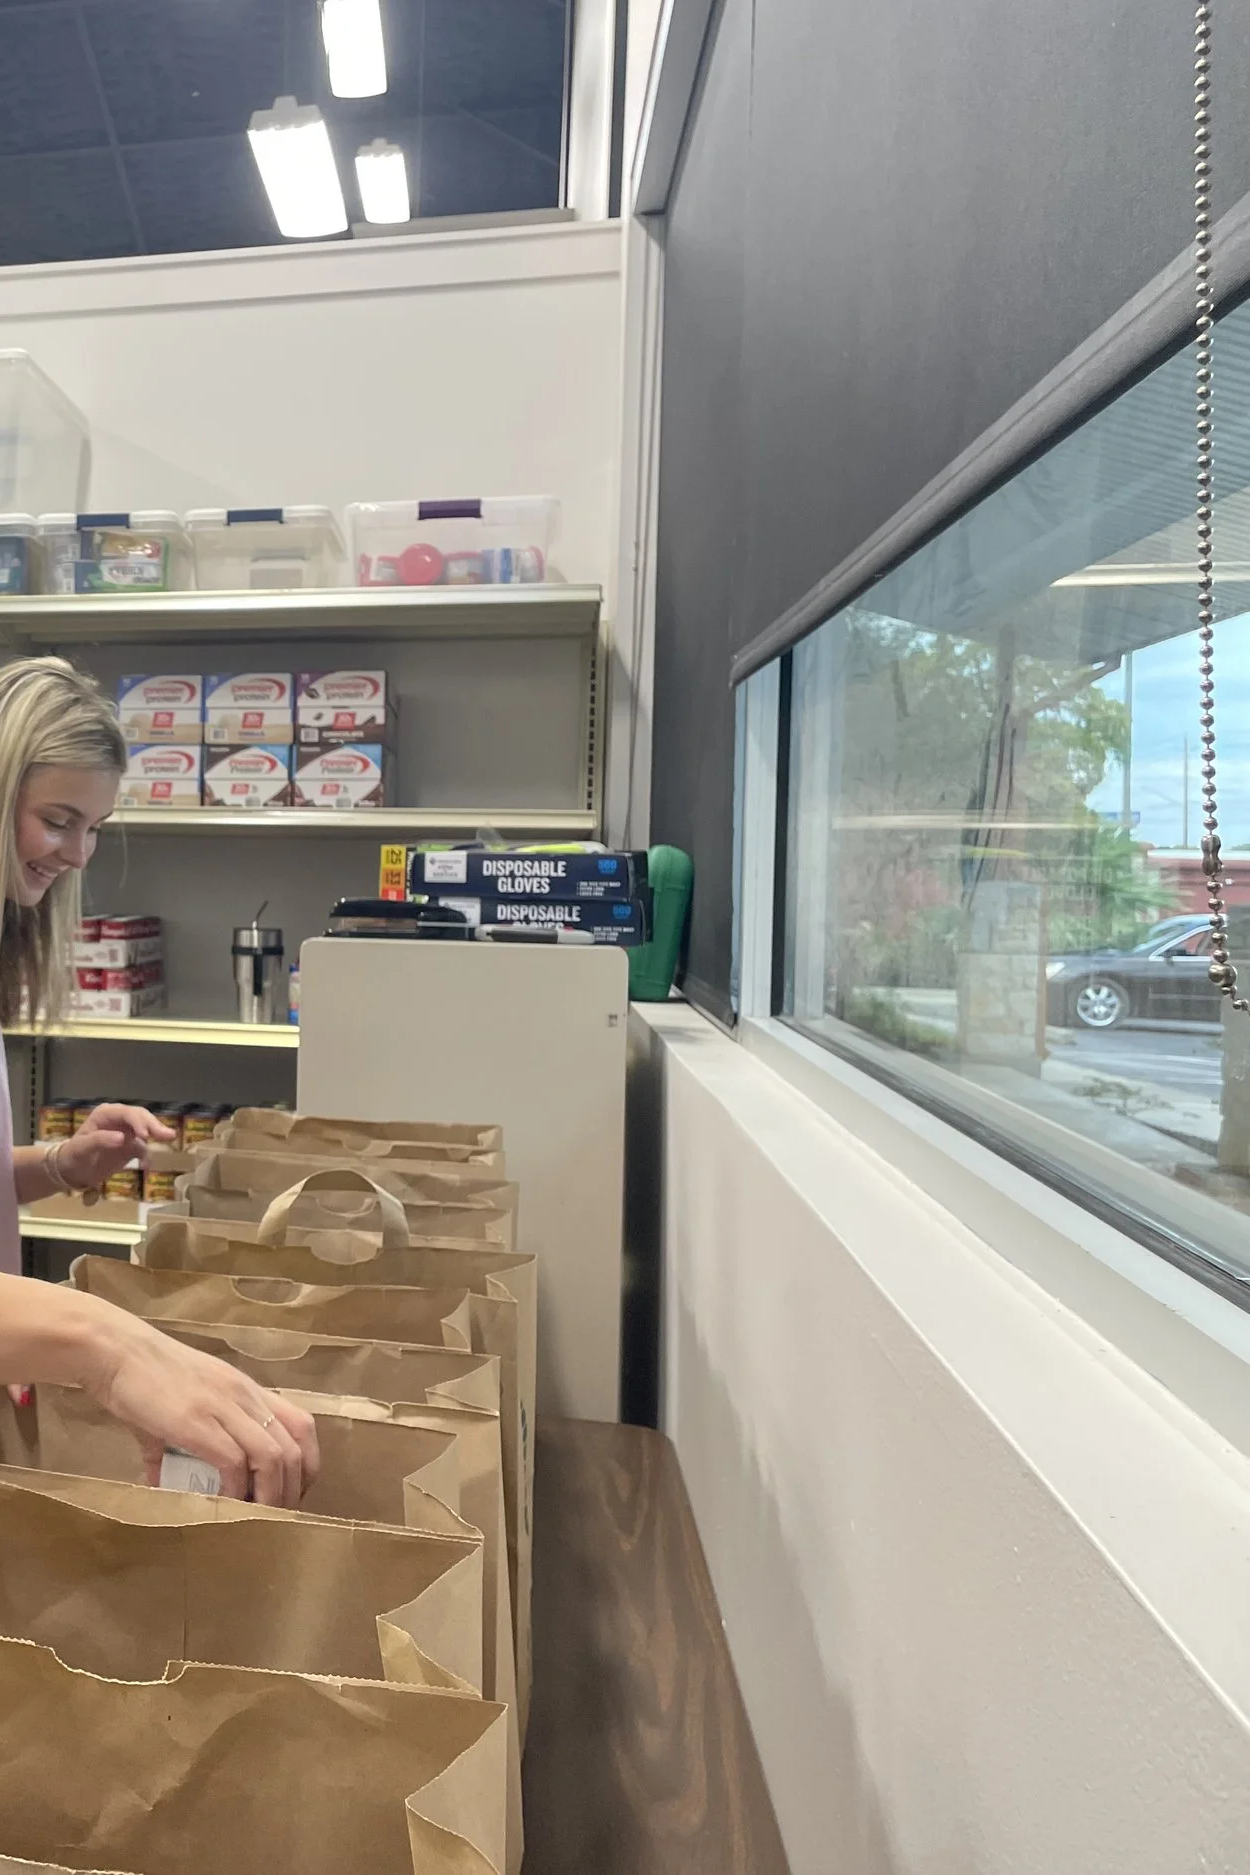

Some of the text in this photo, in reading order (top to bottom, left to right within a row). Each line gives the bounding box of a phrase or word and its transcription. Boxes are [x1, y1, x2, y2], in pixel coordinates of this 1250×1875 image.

[482, 859, 567, 877] DISPOSABLE
[497, 876, 551, 894] GLOVES
[497, 904, 582, 922] DISPOSABLE
